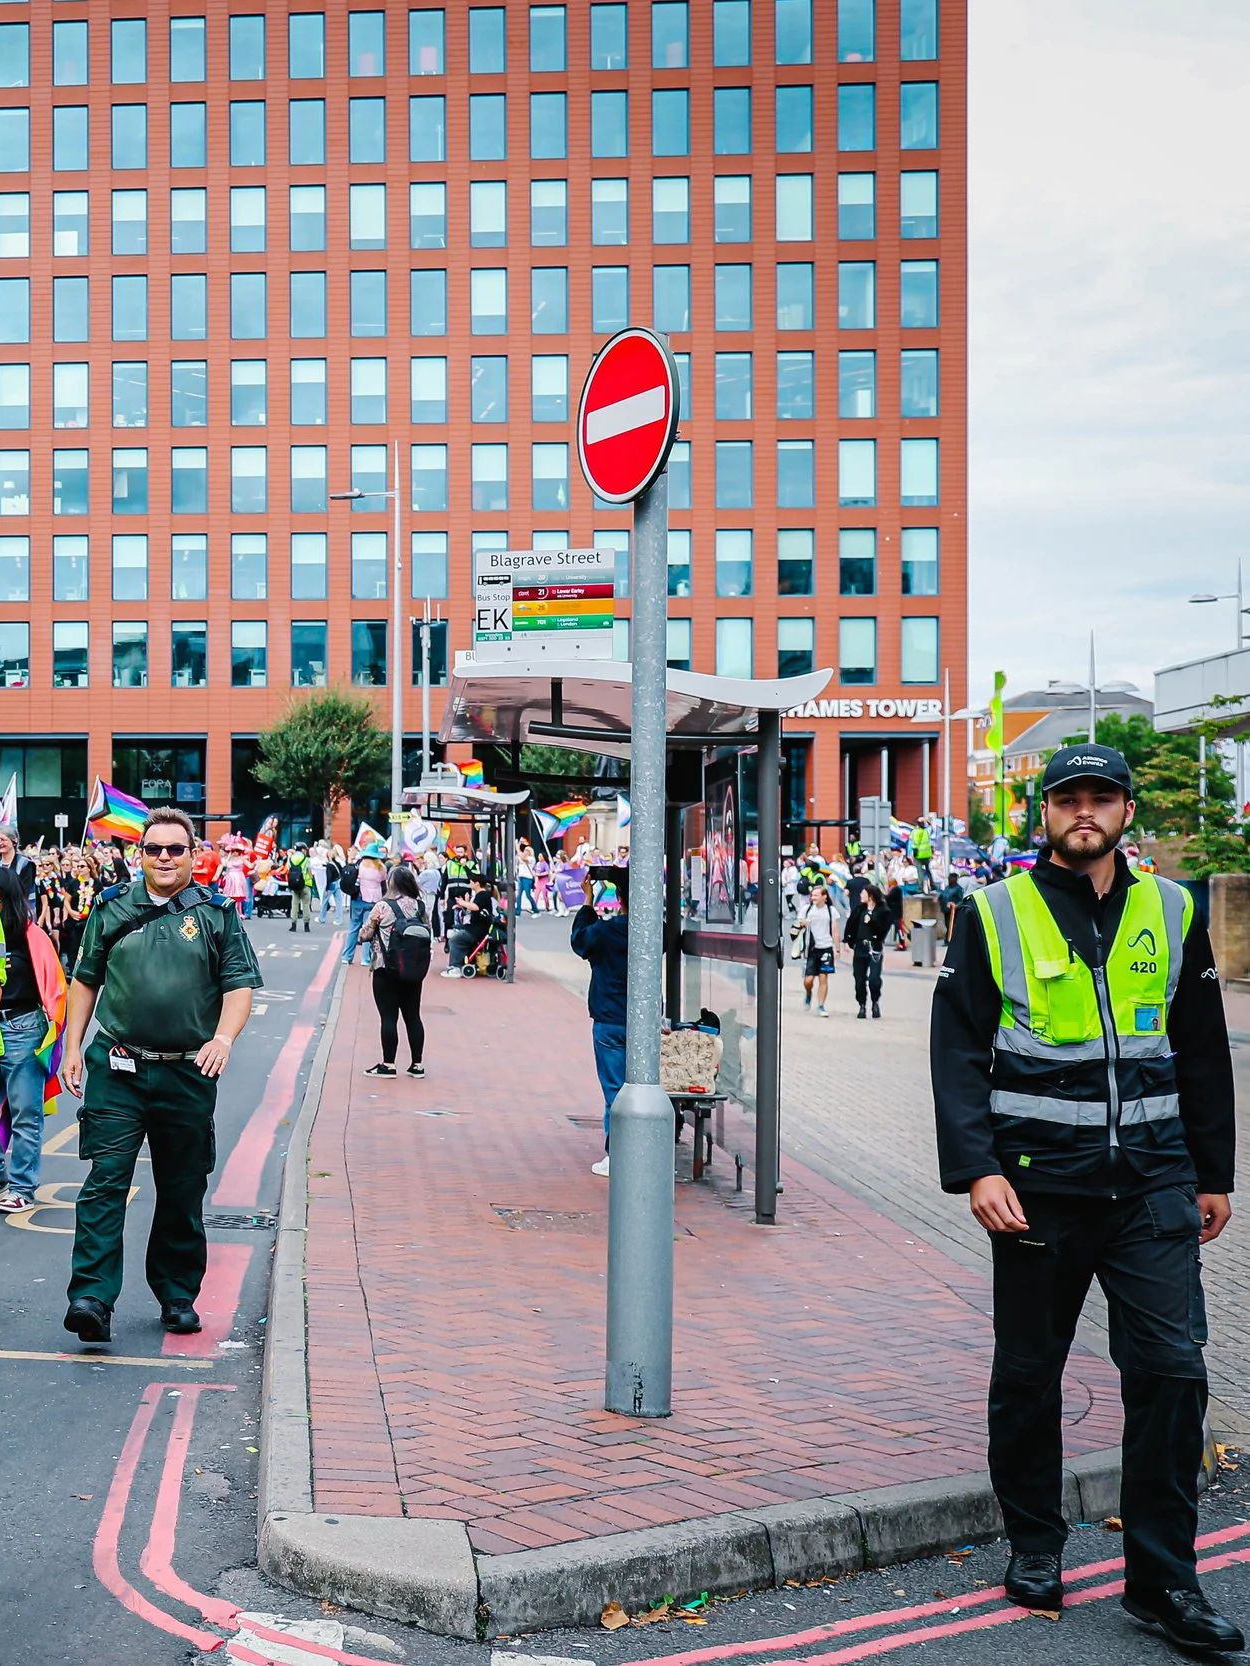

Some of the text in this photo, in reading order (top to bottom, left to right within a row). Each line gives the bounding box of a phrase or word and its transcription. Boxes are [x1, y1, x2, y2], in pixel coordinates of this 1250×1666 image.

[490, 552, 602, 569] Blagrave Street
[492, 593, 511, 602] Stop
[537, 588, 545, 596] 21
[477, 608, 509, 631] EK
[782, 700, 943, 718] HAMES TOWER
[141, 779, 172, 789] FORA
[1130, 961, 1158, 974] 420
